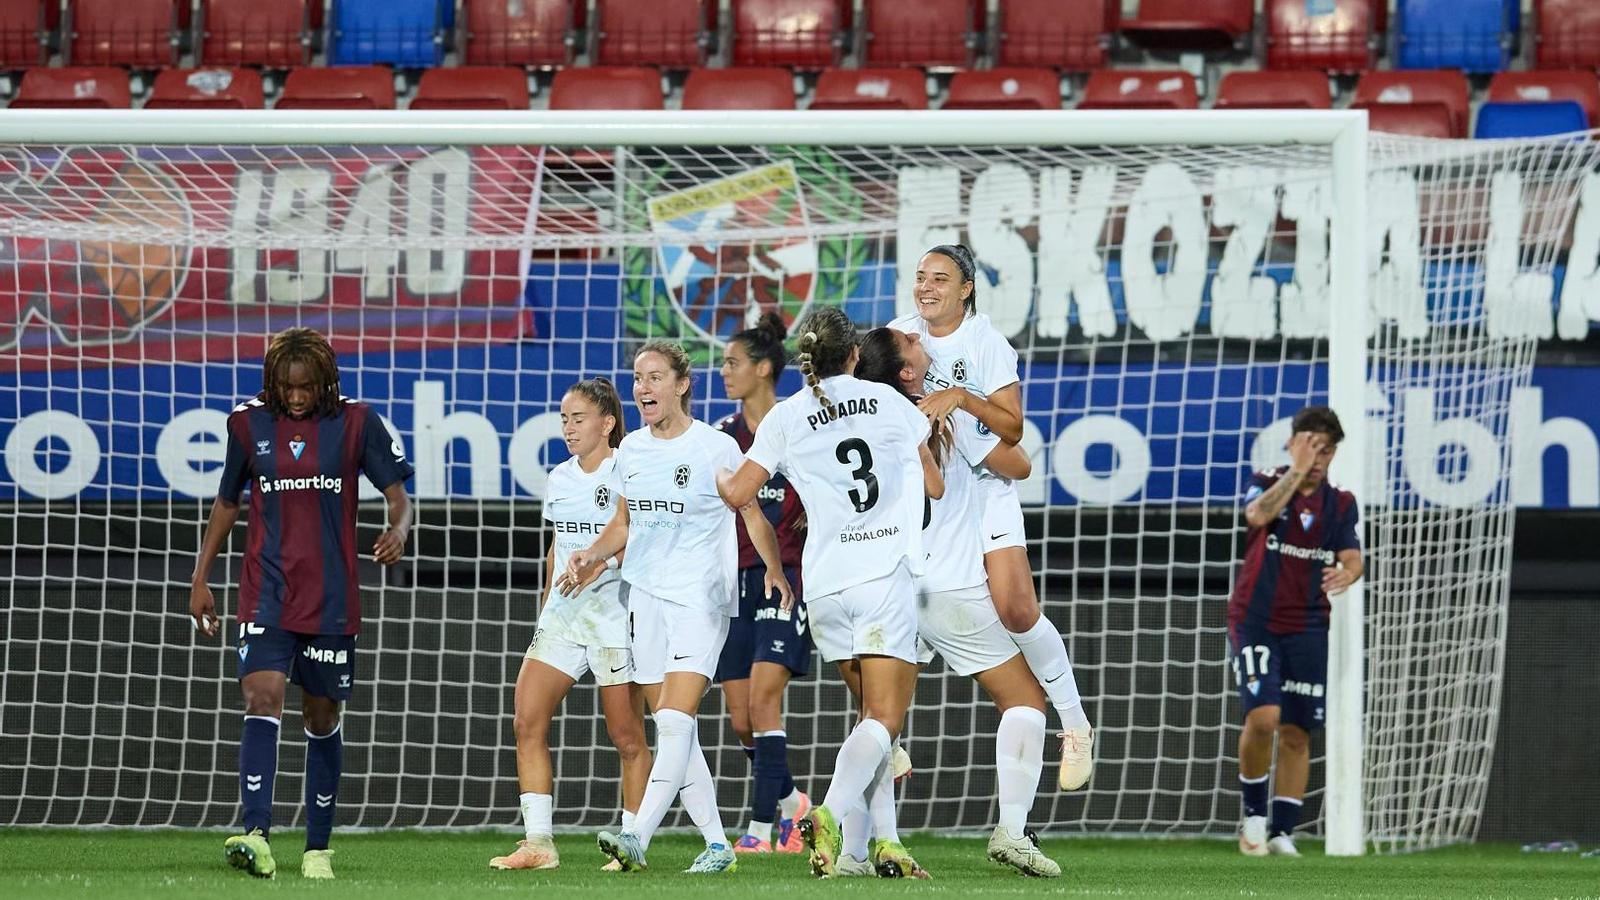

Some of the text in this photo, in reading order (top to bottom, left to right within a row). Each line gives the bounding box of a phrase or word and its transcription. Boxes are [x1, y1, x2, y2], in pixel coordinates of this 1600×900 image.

[274, 474, 342, 494] smartlog
[835, 437, 880, 513] 3
[841, 525, 900, 543] BADALONA
[1280, 541, 1335, 564] smartlog
[303, 646, 334, 663] JMR
[1242, 645, 1271, 675] 17
